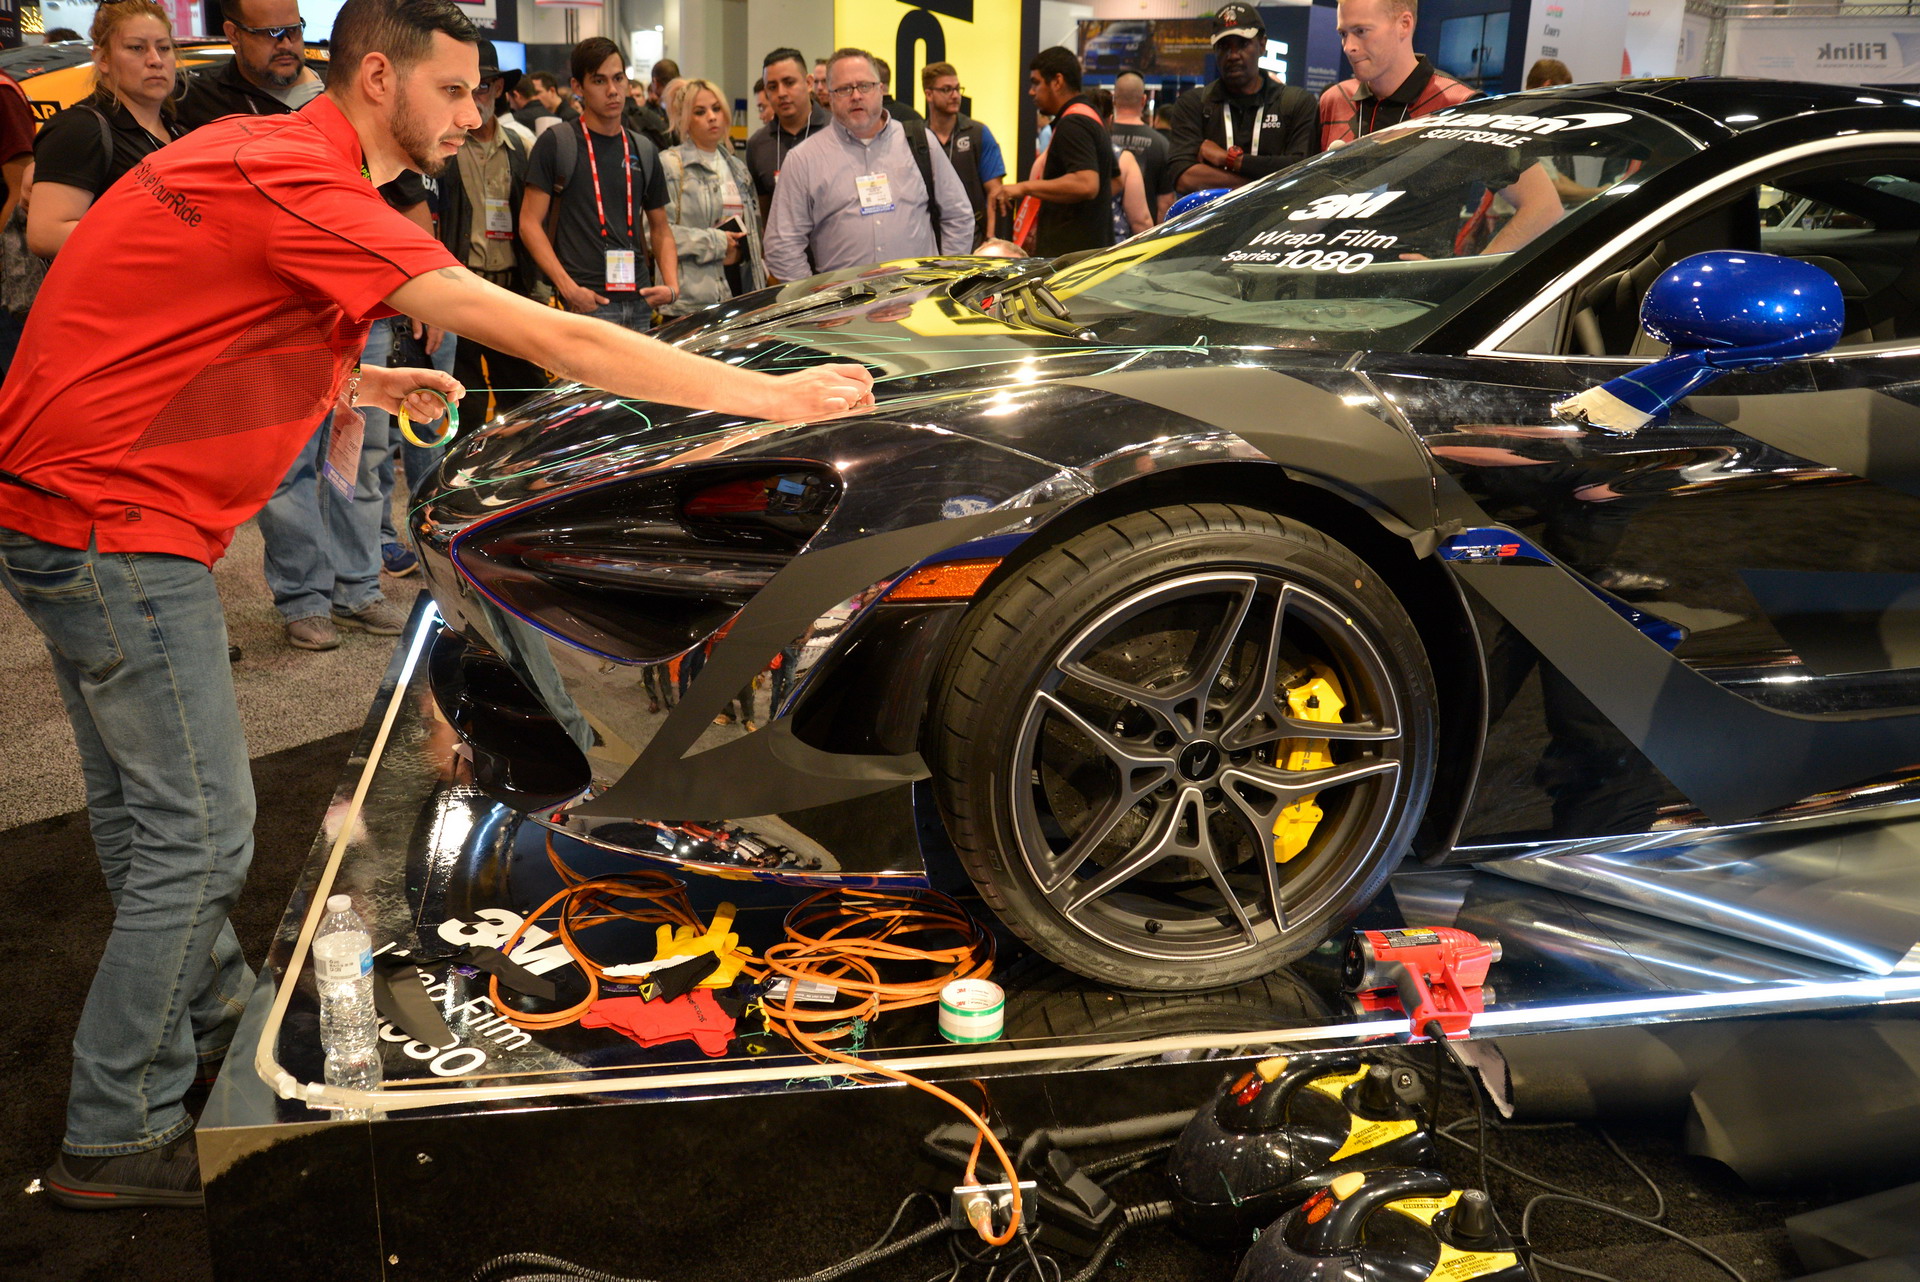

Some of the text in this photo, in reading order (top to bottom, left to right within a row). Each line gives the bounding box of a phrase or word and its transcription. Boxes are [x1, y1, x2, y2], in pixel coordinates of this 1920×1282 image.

[1419, 128, 1533, 148] SCOTTSDALE
[1287, 190, 1407, 221] 3M
[1248, 229, 1398, 249] Wrap Film
[1221, 249, 1375, 274] Series 1080
[437, 908, 575, 976] 3M
